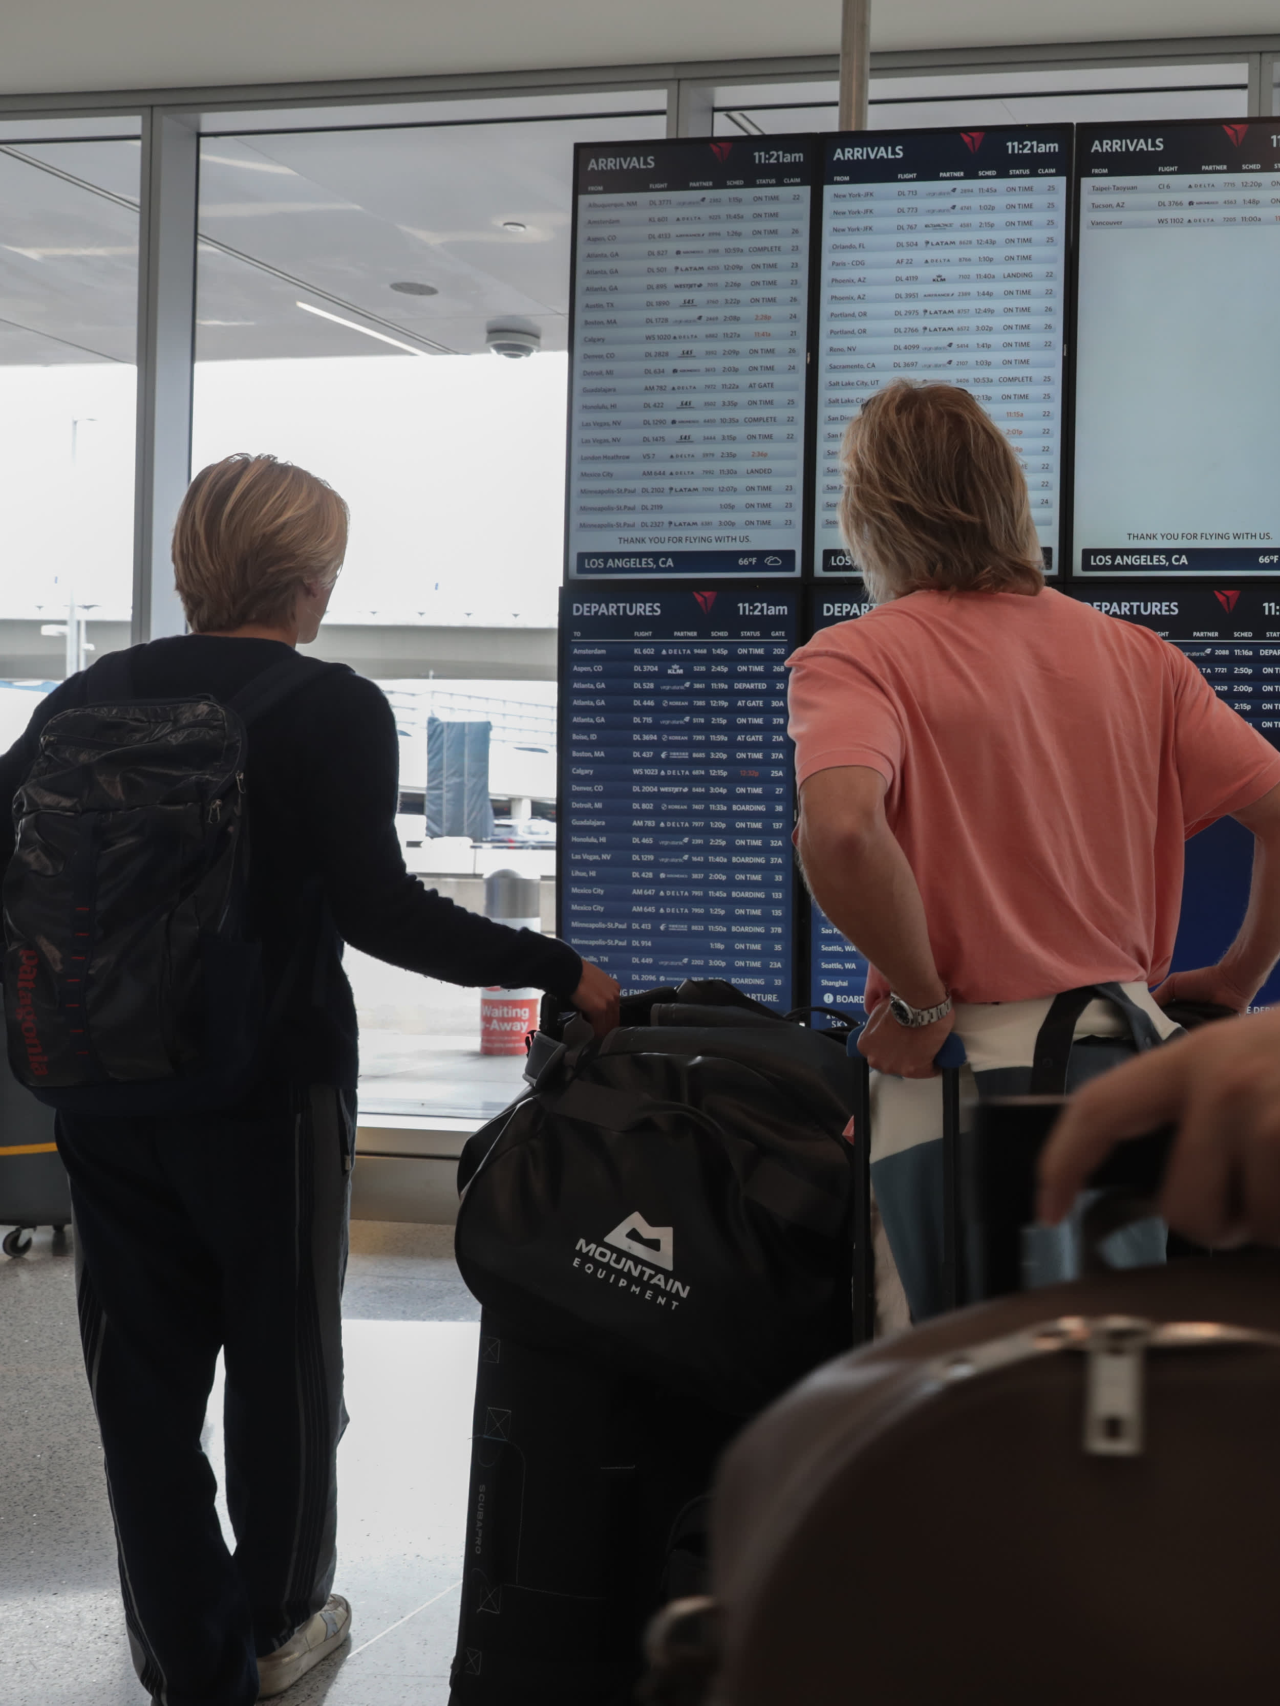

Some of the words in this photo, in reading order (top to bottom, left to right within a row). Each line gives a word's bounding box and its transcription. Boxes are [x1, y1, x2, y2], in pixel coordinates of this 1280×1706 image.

[1006, 141, 1058, 154] 11:21am
[1091, 138, 1164, 153] ARRIVALS
[754, 151, 803, 164] 11:21am
[833, 145, 903, 161] ARRIVALS
[588, 156, 655, 171] ARRIVALS
[1160, 533, 1179, 541] YOU
[1200, 532, 1230, 540] FLYING
[1232, 532, 1257, 540] WITH
[1259, 532, 1273, 540] US.
[1091, 555, 1112, 565] LOS
[1114, 555, 1169, 566] ANGELES,
[1171, 555, 1188, 565] CA
[573, 603, 661, 616] DEPARTURES
[737, 602, 788, 615] 11:21am
[1084, 602, 1179, 616] EPARTURES
[592, 887, 604, 895] City
[15, 949, 49, 1076] patagonia
[482, 1005, 529, 1020] Waiting
[575, 1236, 690, 1300] MOUNTAIN
[573, 1257, 680, 1311] EQUIPMENT
[474, 1484, 486, 1555] SCUBAPRO
